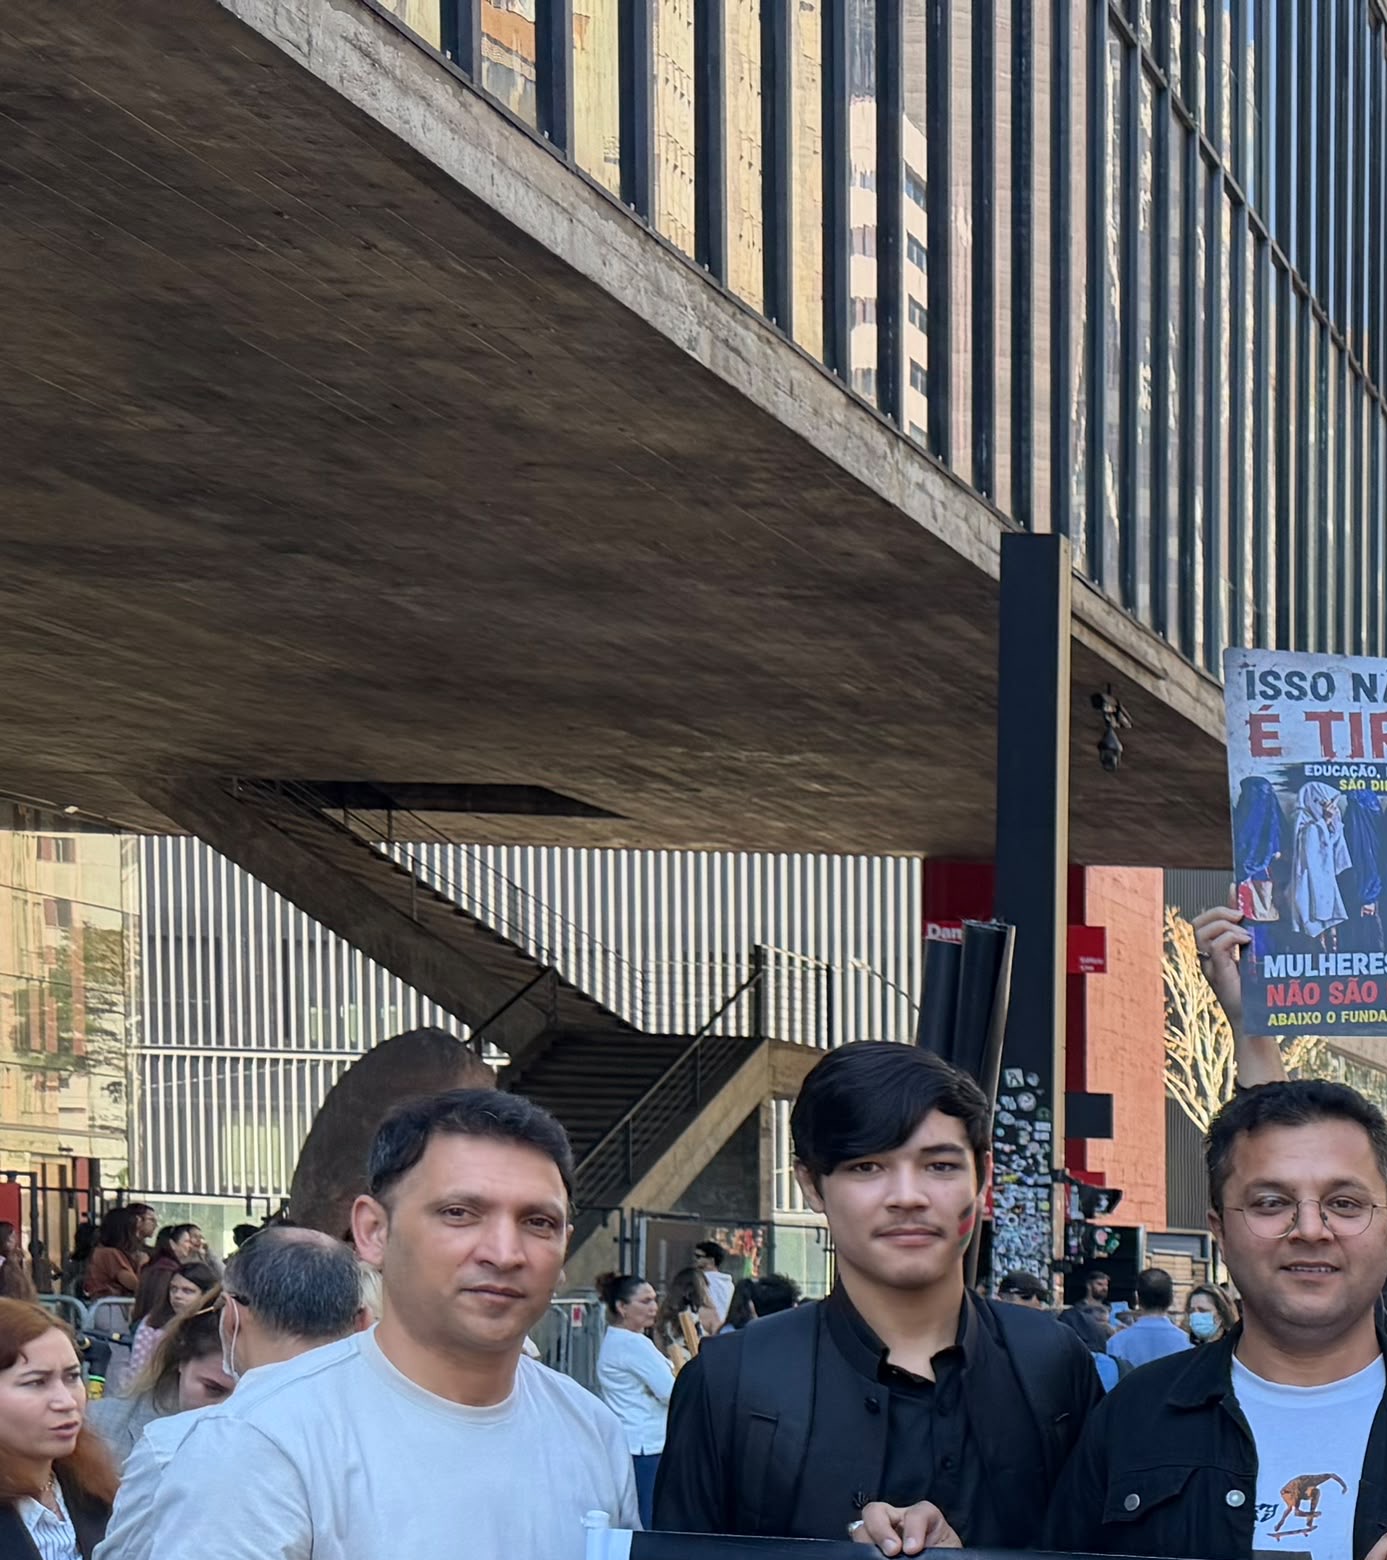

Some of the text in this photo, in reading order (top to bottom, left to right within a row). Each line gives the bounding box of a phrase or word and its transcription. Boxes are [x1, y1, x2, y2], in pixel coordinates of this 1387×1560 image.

[1246, 669, 1336, 702] ISSO
[1246, 705, 1282, 758] É
[1304, 762, 1381, 780] EDUCAÇÃO,
[1339, 777, 1365, 791] SÃO
[1266, 979, 1320, 1008] NÃO
[1329, 977, 1378, 1006] SÃO
[1268, 1010, 1321, 1026] ABAIXO
[1326, 1010, 1336, 1024] O
